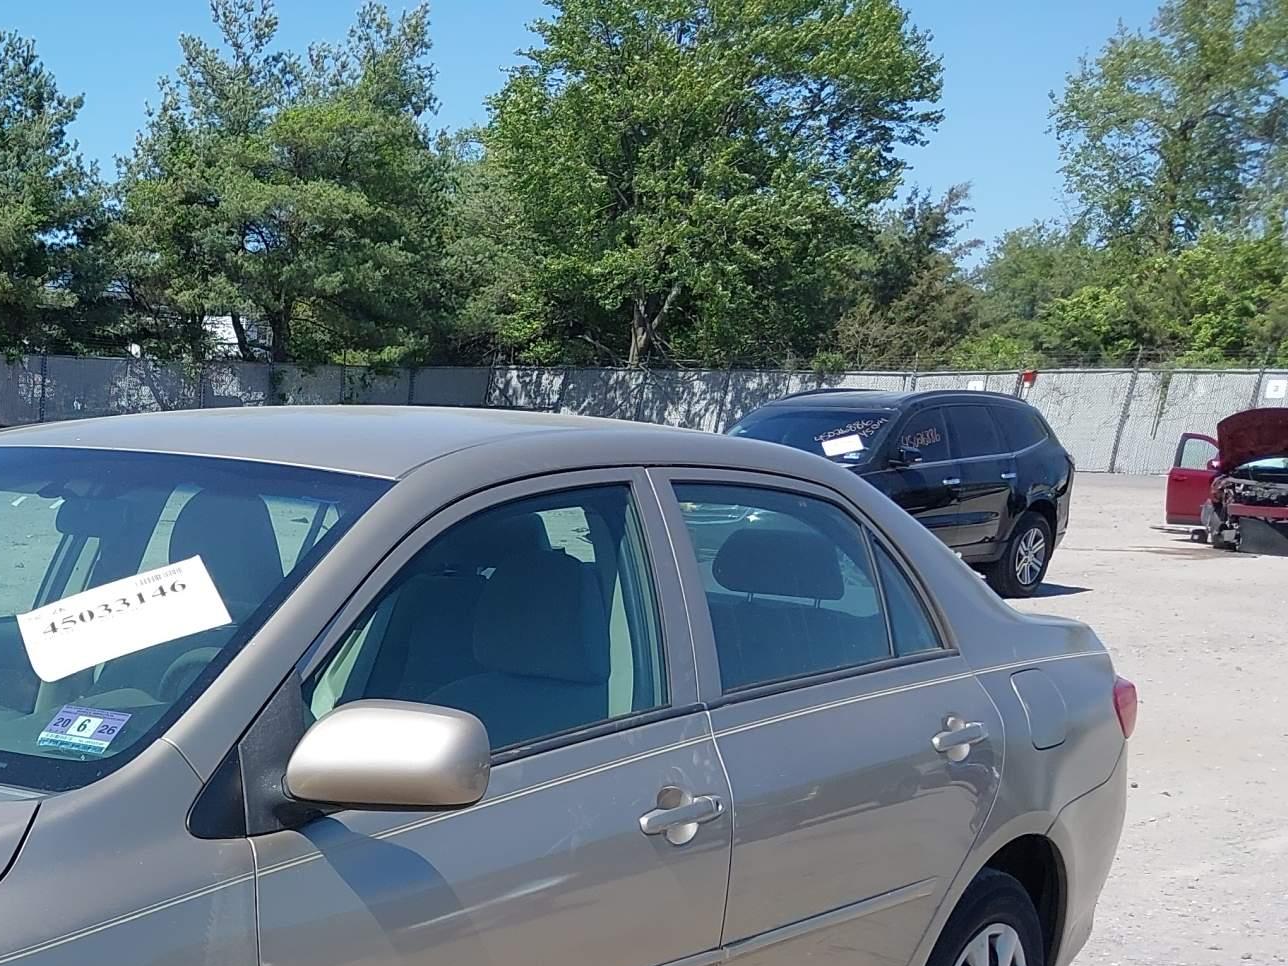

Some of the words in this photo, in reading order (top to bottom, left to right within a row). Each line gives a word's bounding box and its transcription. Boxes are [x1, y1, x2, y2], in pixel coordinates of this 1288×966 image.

[42, 579, 187, 636] 45033146
[53, 717, 72, 728] 20
[76, 718, 91, 733] 6
[97, 724, 118, 735] 26
